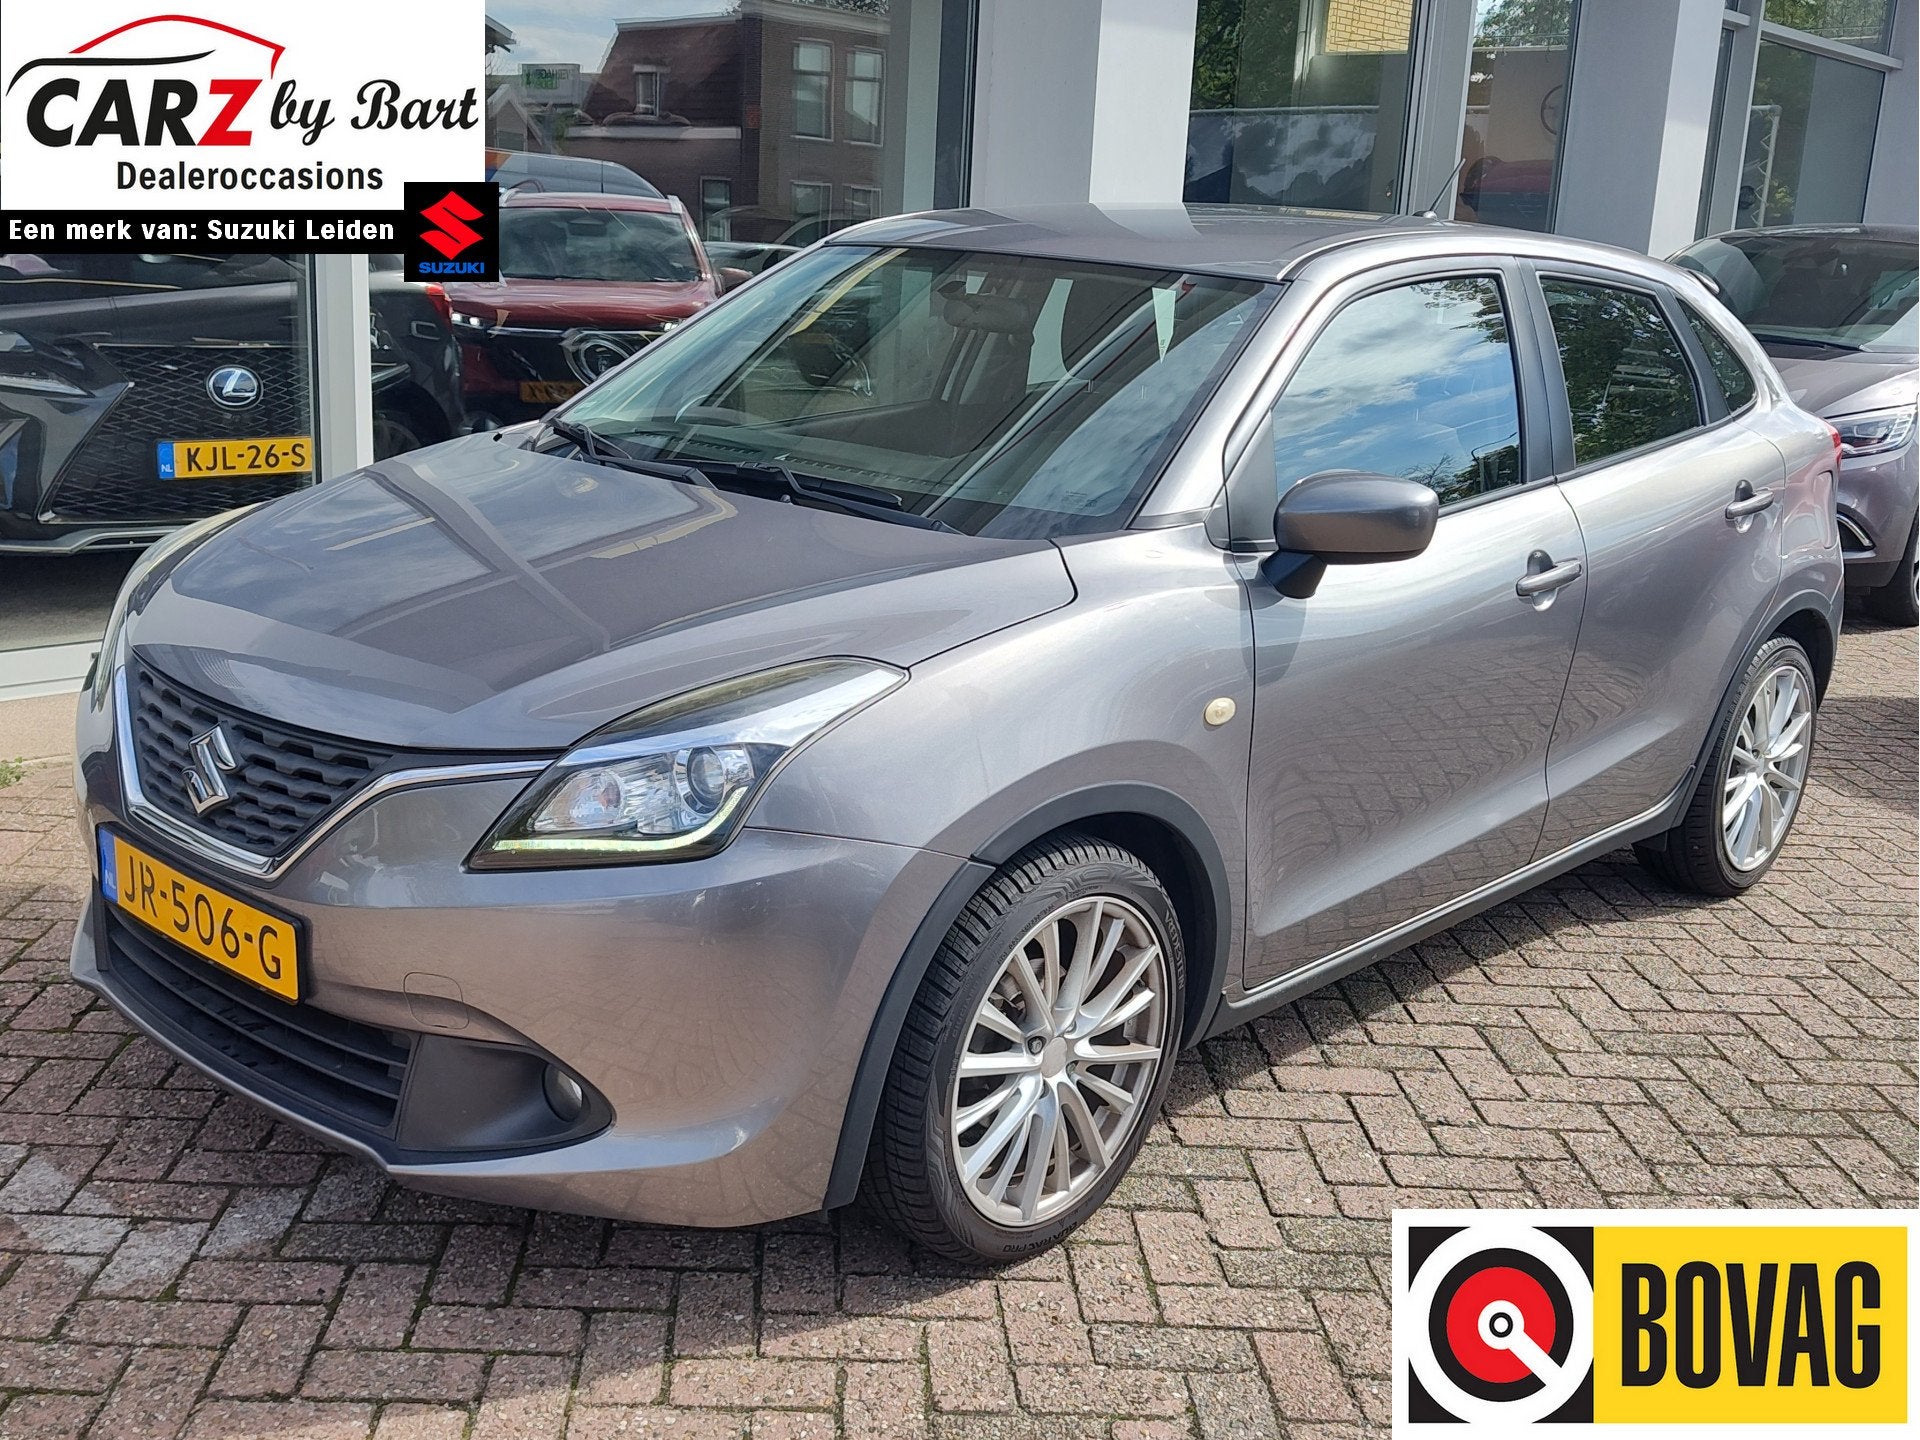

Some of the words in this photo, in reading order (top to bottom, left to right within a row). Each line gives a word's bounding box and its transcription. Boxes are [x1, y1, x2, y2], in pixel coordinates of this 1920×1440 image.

[161, 463, 174, 472] NL
[186, 443, 306, 472] KJL-26-S
[124, 855, 282, 980] JR-506-G
